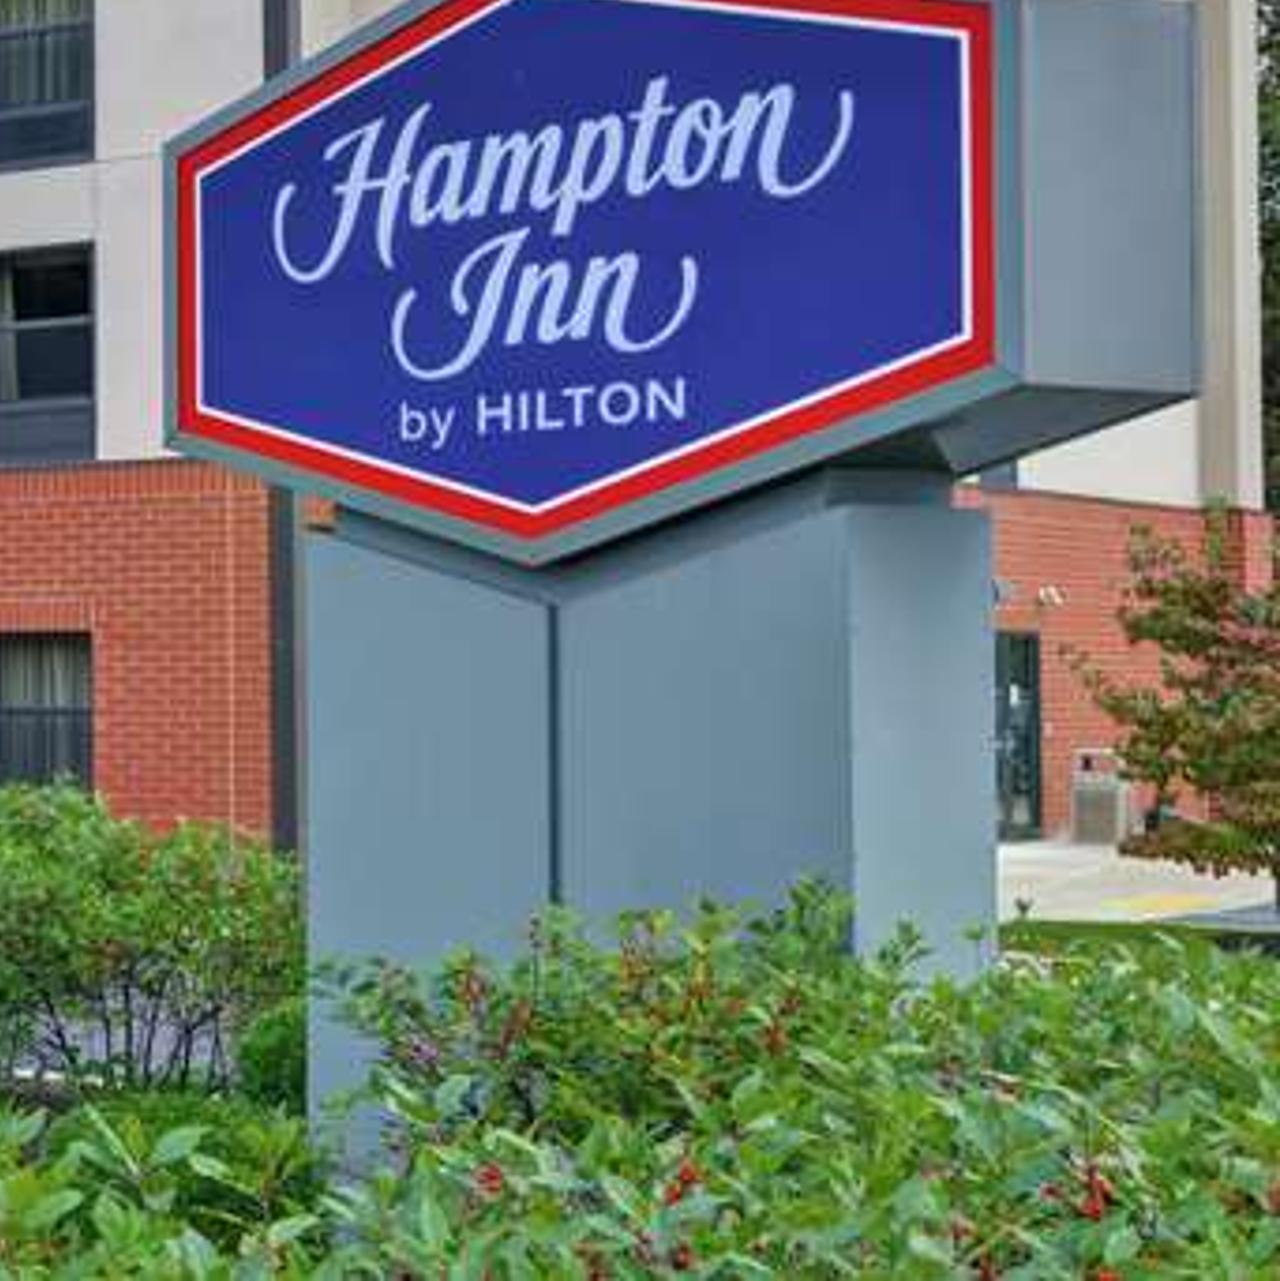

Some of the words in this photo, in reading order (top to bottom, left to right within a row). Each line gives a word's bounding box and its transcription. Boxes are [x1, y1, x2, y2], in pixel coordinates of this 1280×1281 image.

[274, 76, 854, 284] Hampton
[391, 227, 698, 381] Inn
[400, 401, 455, 450] by
[477, 377, 686, 435] HILTON
